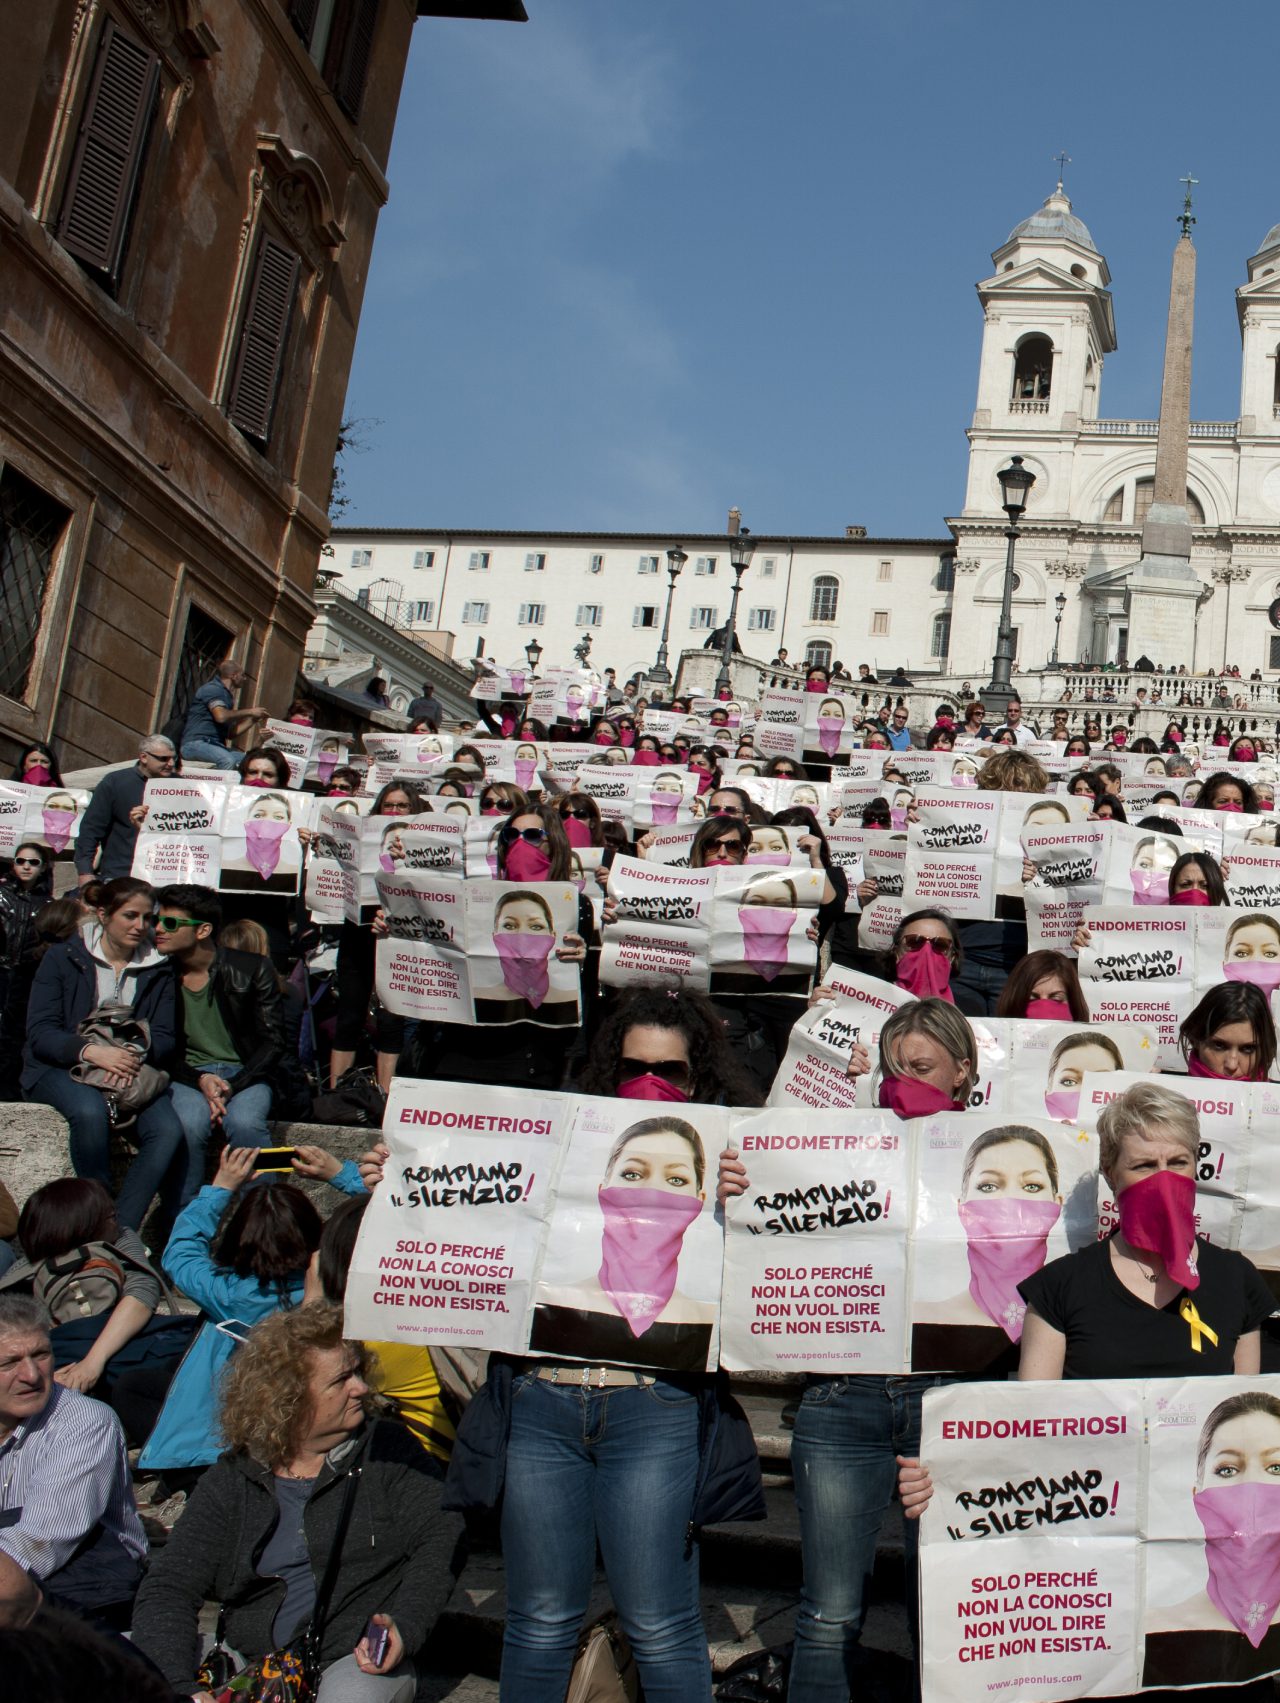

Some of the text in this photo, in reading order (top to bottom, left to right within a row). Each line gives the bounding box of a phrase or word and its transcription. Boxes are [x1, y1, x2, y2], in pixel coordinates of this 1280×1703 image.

[918, 799, 993, 810] ENDOMETRIOSI
[922, 823, 981, 836] ROMPIAMO
[925, 829, 988, 848] SILENZIO!
[1028, 834, 1104, 847] ENDOMETRIOSI
[620, 867, 709, 885] ENDOMETRIOSI
[946, 864, 976, 872] PERCHÉ
[947, 873, 981, 881] CONOSCI
[379, 882, 455, 903] ENDOMETRIOSI
[620, 897, 692, 907] ROMPIAMO
[951, 891, 980, 899] ESISTA.
[1088, 921, 1186, 931] ENDOMETRIOSI
[1095, 950, 1173, 969] ROMPIAMO
[1102, 956, 1182, 982] SILENZIO!
[390, 962, 459, 981] NON LA CONOSCI
[1101, 1001, 1170, 1011] SOLO PERCHÉ
[1093, 1014, 1178, 1022] NON LA CONOSCI
[399, 1108, 552, 1135] ENDOMETRIOSI
[742, 1135, 899, 1151] ENDOMETRIOSI
[402, 1162, 522, 1185] ROMPIAMO
[408, 1173, 535, 1208] SILENZIO!
[754, 1179, 876, 1214] ROMPIAMO
[765, 1189, 892, 1235] SILENZIO!
[396, 1240, 505, 1261] SOLO PERCHÉ
[378, 1257, 513, 1279] NON LA CONOSCI
[764, 1264, 873, 1280] SOLO PERCHÉ
[380, 1275, 506, 1296] NON VUOL DIRE
[752, 1284, 885, 1299] NON LA CONOSCI
[373, 1292, 510, 1314] CHE NON ESISTA.
[756, 1302, 880, 1317] NON VUOL DIRE
[396, 1323, 484, 1336] www.apeonlus.com
[751, 1319, 885, 1335] CHE NON ESISTA.
[776, 1351, 861, 1361] www.apeonlus.com
[942, 1416, 1127, 1439] ENDOMETRIOSI
[956, 1469, 1102, 1512] ROMPIAMO
[969, 1481, 1120, 1538] SILENZIO!
[972, 1569, 1098, 1593] SOLO PERCHÉ
[957, 1593, 1112, 1618] NON LA CONOSCI
[964, 1615, 1106, 1639] NON VUOL DIRE
[958, 1636, 1111, 1663] CHE NON ESISTA.
[987, 1674, 1082, 1691] www.apeonlus.com
